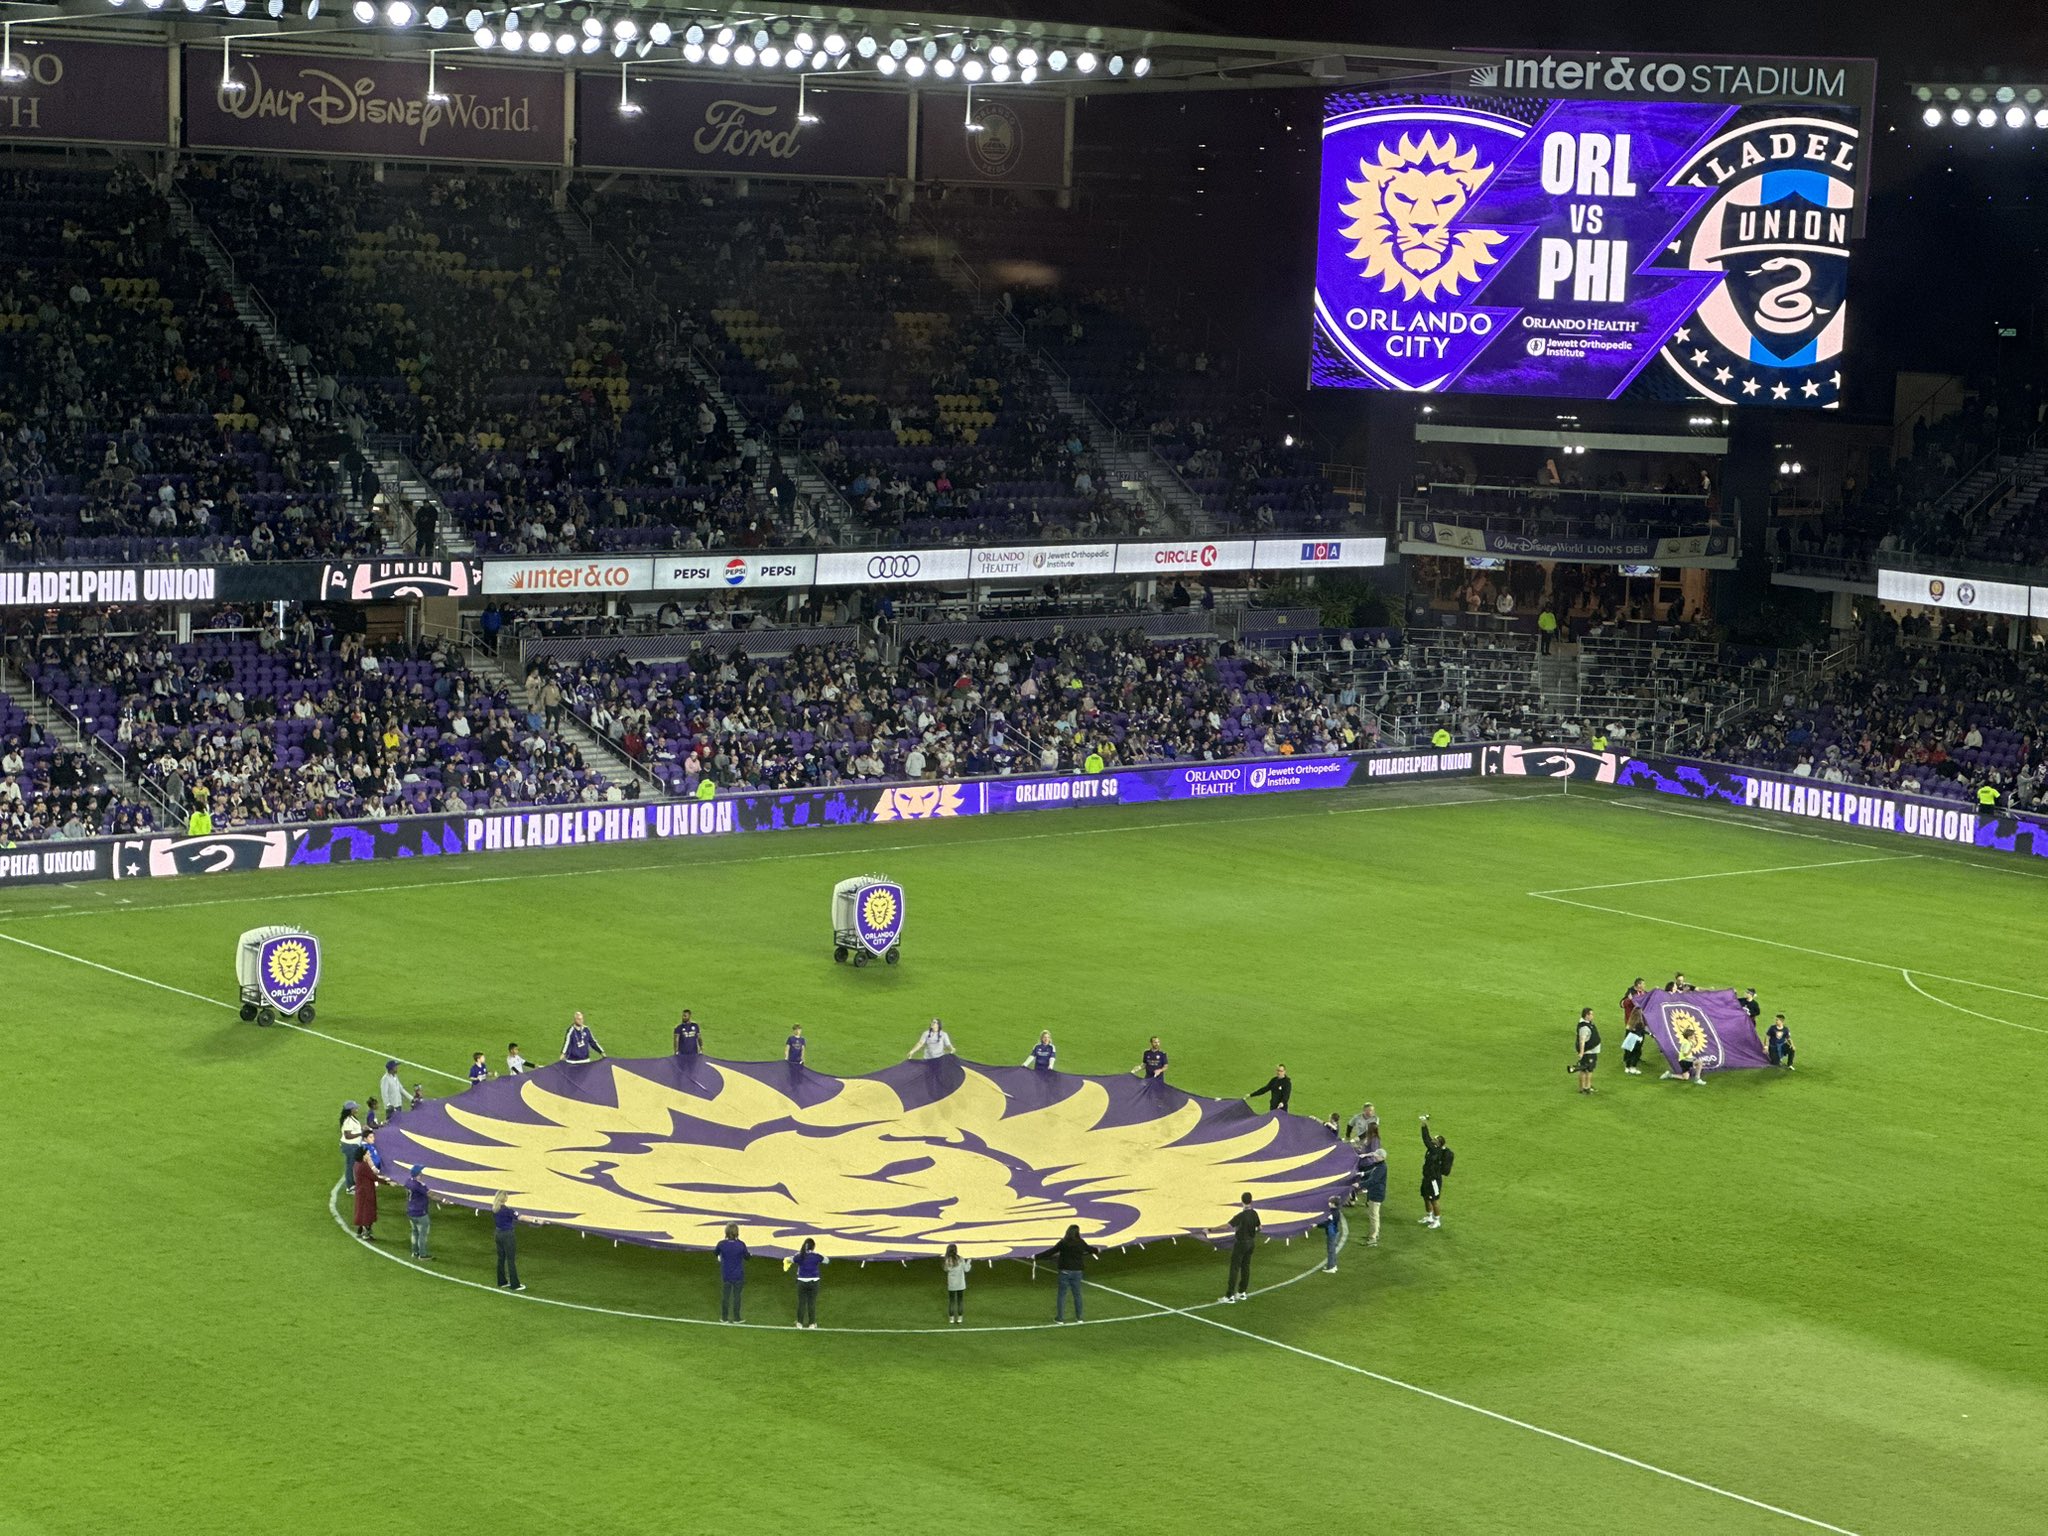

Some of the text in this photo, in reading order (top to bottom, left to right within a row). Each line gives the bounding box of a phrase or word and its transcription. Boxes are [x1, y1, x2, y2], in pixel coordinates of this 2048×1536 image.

[1690, 64, 1846, 97] STADIUM
[444, 93, 530, 132] World
[694, 100, 802, 158] Ford
[1541, 130, 1637, 198] ORL
[1570, 203, 1604, 235] VS
[1738, 208, 1846, 244] UNION
[1537, 237, 1628, 303] PHI
[1345, 307, 1493, 336] ORLANDO
[1522, 315, 1636, 332] ORLANDO HEALTH
[1385, 335, 1451, 359] CITY
[1546, 338, 1633, 352] Jewett Orthopedic
[1546, 347, 1586, 358] Institute
[977, 551, 1025, 563] ORLANDO
[1071, 549, 1110, 560] Orthopedic
[1155, 546, 1217, 565] CIRCLE K
[1587, 544, 1623, 554] LION'S
[1626, 544, 1648, 554] DEN
[380, 561, 442, 577] UNION
[761, 565, 796, 577] PEPSI
[981, 563, 1018, 574] HEALTH
[1046, 559, 1075, 568] Institute
[673, 567, 710, 580] PEPSI
[725, 568, 746, 576] PEPSI
[143, 567, 215, 601] UNION
[1267, 762, 1341, 777] Jewett Orthopedic
[1368, 752, 1473, 777] PHILADELPHIA UNION
[1185, 768, 1241, 783] ORLANDO
[1267, 776, 1301, 787] Institute
[1015, 778, 1119, 803] ORLANDO CITY SC
[1190, 782, 1235, 796] HEALTH
[1745, 777, 1976, 845] PHILADELPHIA UNION
[467, 800, 733, 851] PHILADELPHIA UNION
[0, 849, 96, 878] PHIA UNION
[865, 931, 894, 939] ORLANDO
[271, 987, 307, 997] ORLANDO
[281, 995, 297, 1003] CITY
